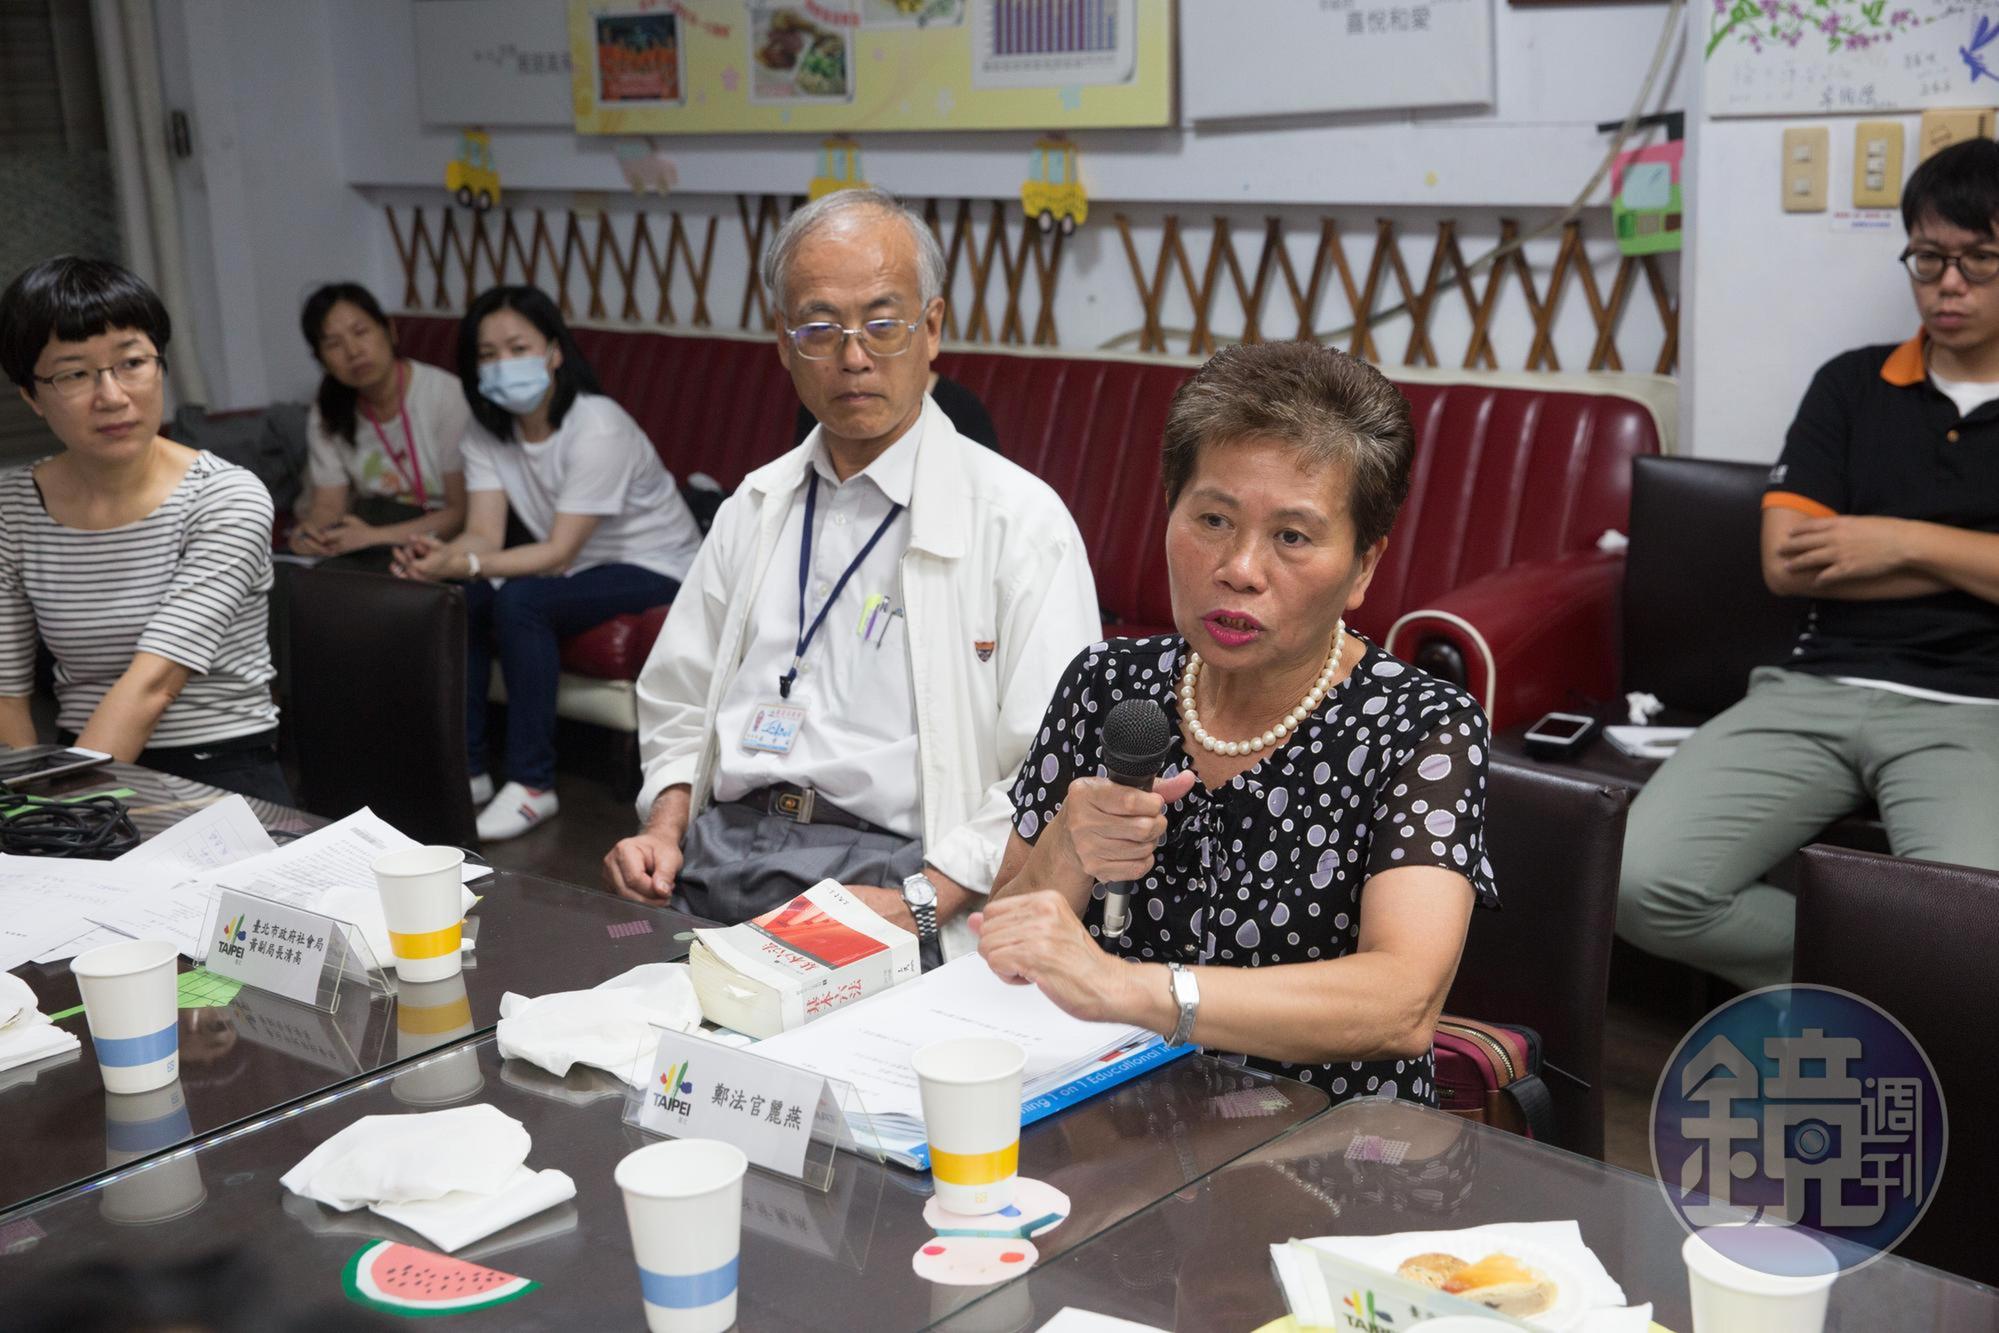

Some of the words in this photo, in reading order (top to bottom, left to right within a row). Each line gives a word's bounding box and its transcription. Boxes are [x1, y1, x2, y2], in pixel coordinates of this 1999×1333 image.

[218, 941, 245, 959] TAIPEI
[252, 919, 324, 952] 臺北市政府社會局
[1060, 1085, 1080, 1096] on
[1086, 1049, 1160, 1084] Educational
[653, 1093, 691, 1117] TAIPEI
[711, 1082, 803, 1131] 鄭法官麗燕
